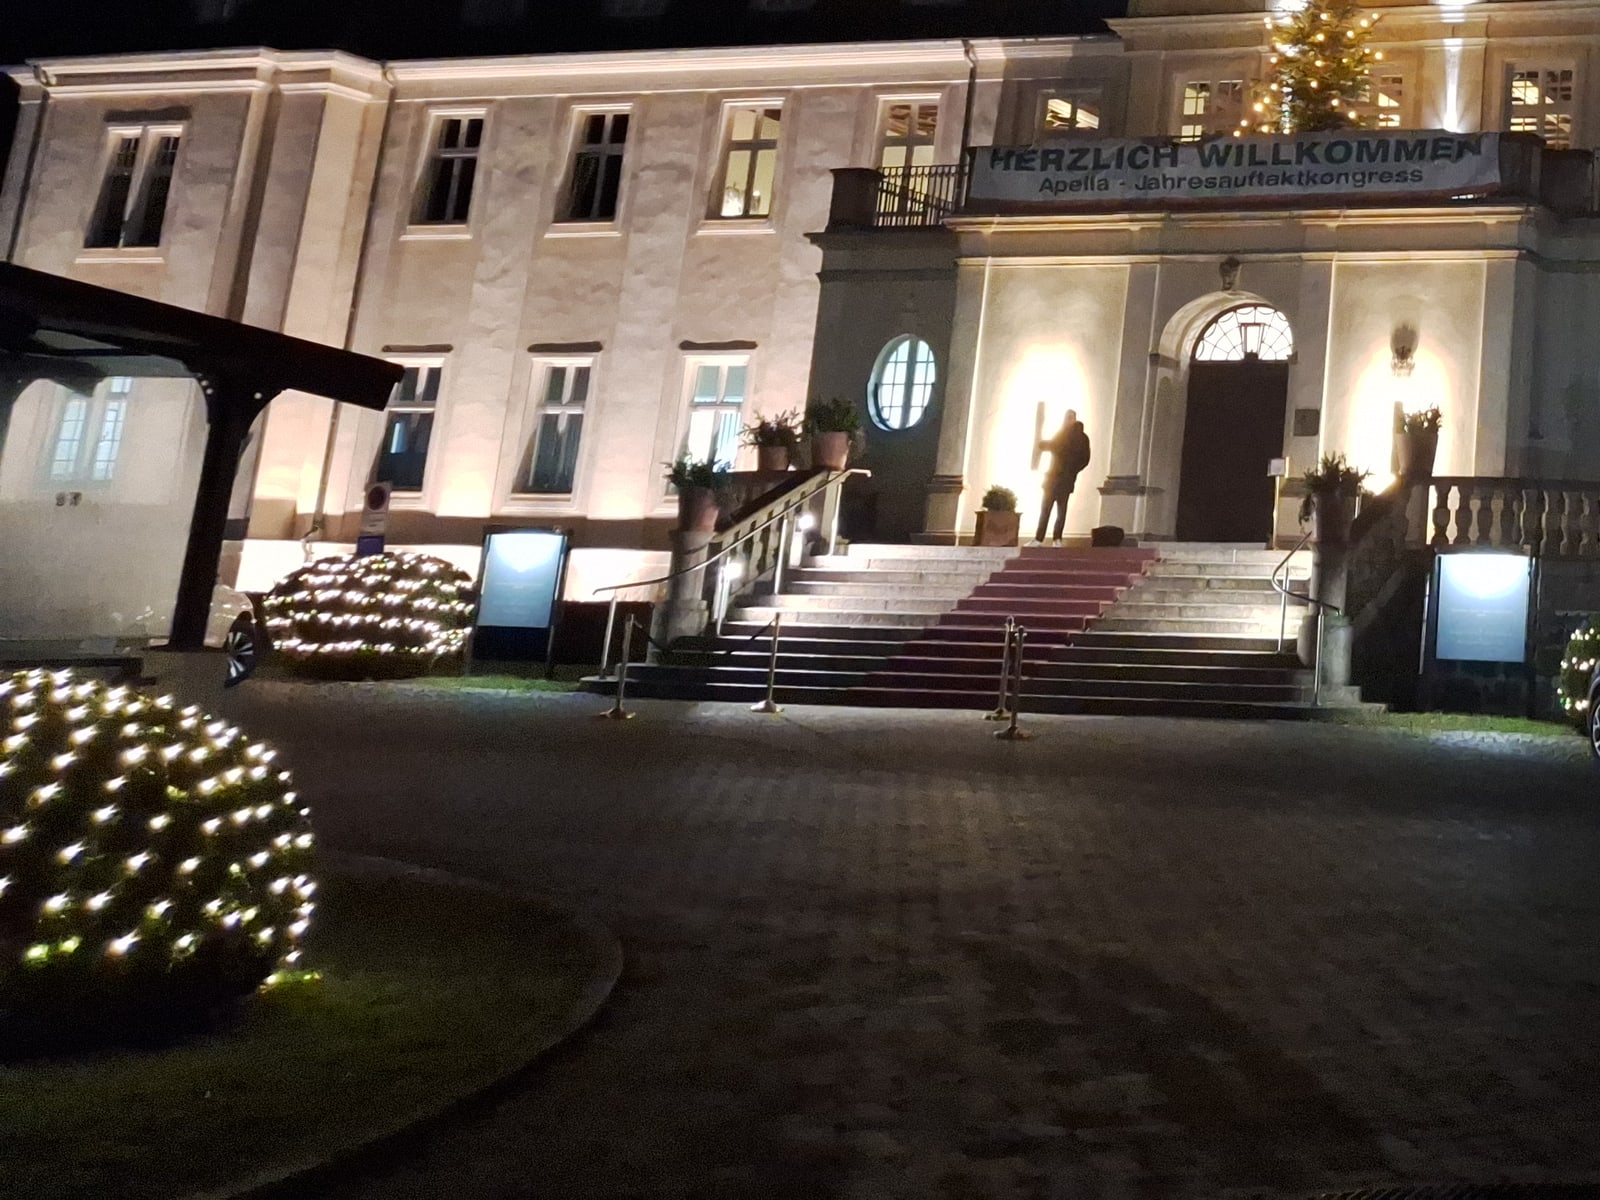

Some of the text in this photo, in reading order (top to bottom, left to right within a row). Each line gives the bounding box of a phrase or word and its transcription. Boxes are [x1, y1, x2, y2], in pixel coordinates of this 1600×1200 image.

[989, 137, 1483, 172] HERZLICH WILLKOMMEN
[1038, 174, 1110, 196] Apella
[1134, 167, 1424, 192] Jahresauftaktkongress
